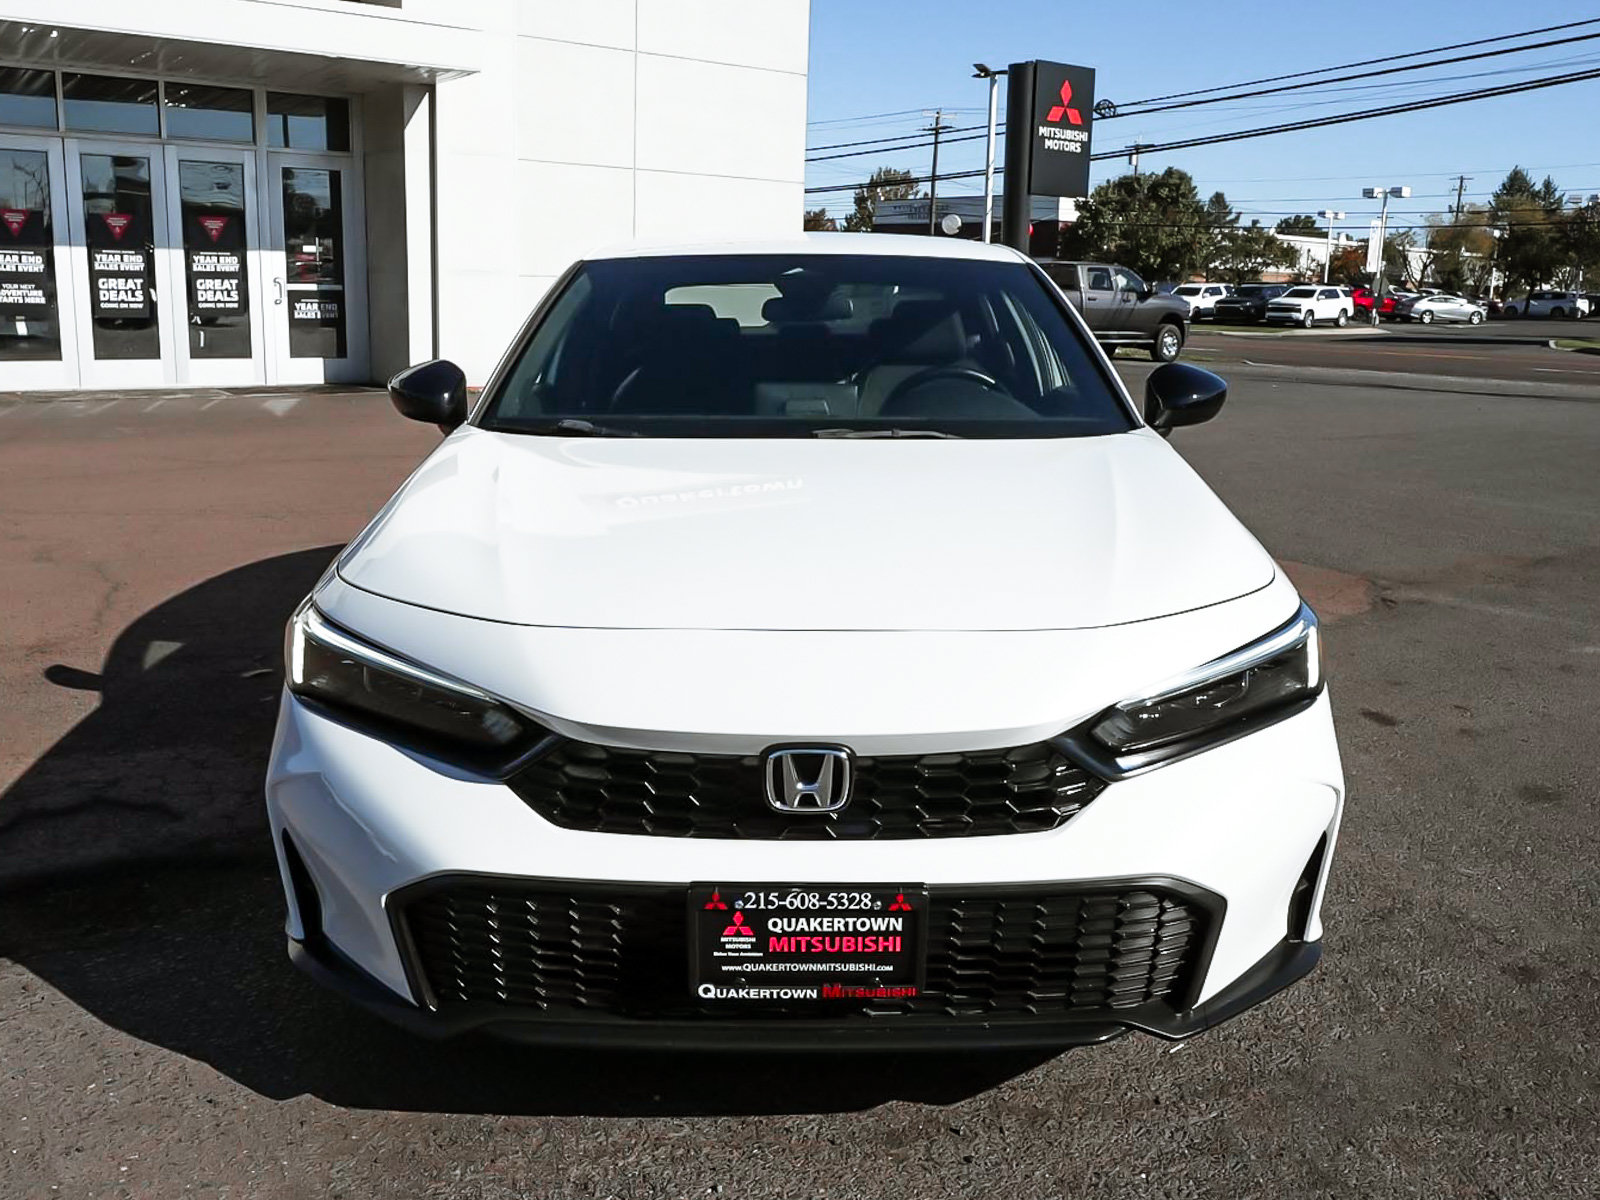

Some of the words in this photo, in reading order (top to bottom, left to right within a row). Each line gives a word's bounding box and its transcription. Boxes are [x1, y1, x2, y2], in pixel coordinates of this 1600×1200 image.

[1039, 126, 1088, 142] MITSUBISHI
[1045, 139, 1081, 153] MOTORS
[0, 254, 19, 263] EAR
[94, 254, 121, 263] YEAR
[123, 254, 143, 263] END
[192, 255, 218, 264] YEAR
[219, 256, 238, 265] END
[98, 278, 143, 290] GREAT
[196, 278, 238, 290] GREAT
[99, 290, 144, 302] DEALS
[197, 290, 239, 302] DEALS
[294, 302, 319, 311] YEAR
[743, 891, 872, 910] 215-608-5328
[767, 917, 903, 933] QUAKERTOWN
[769, 936, 902, 953] MITSUBISHI
[698, 983, 818, 999] QUAKERTOWN
